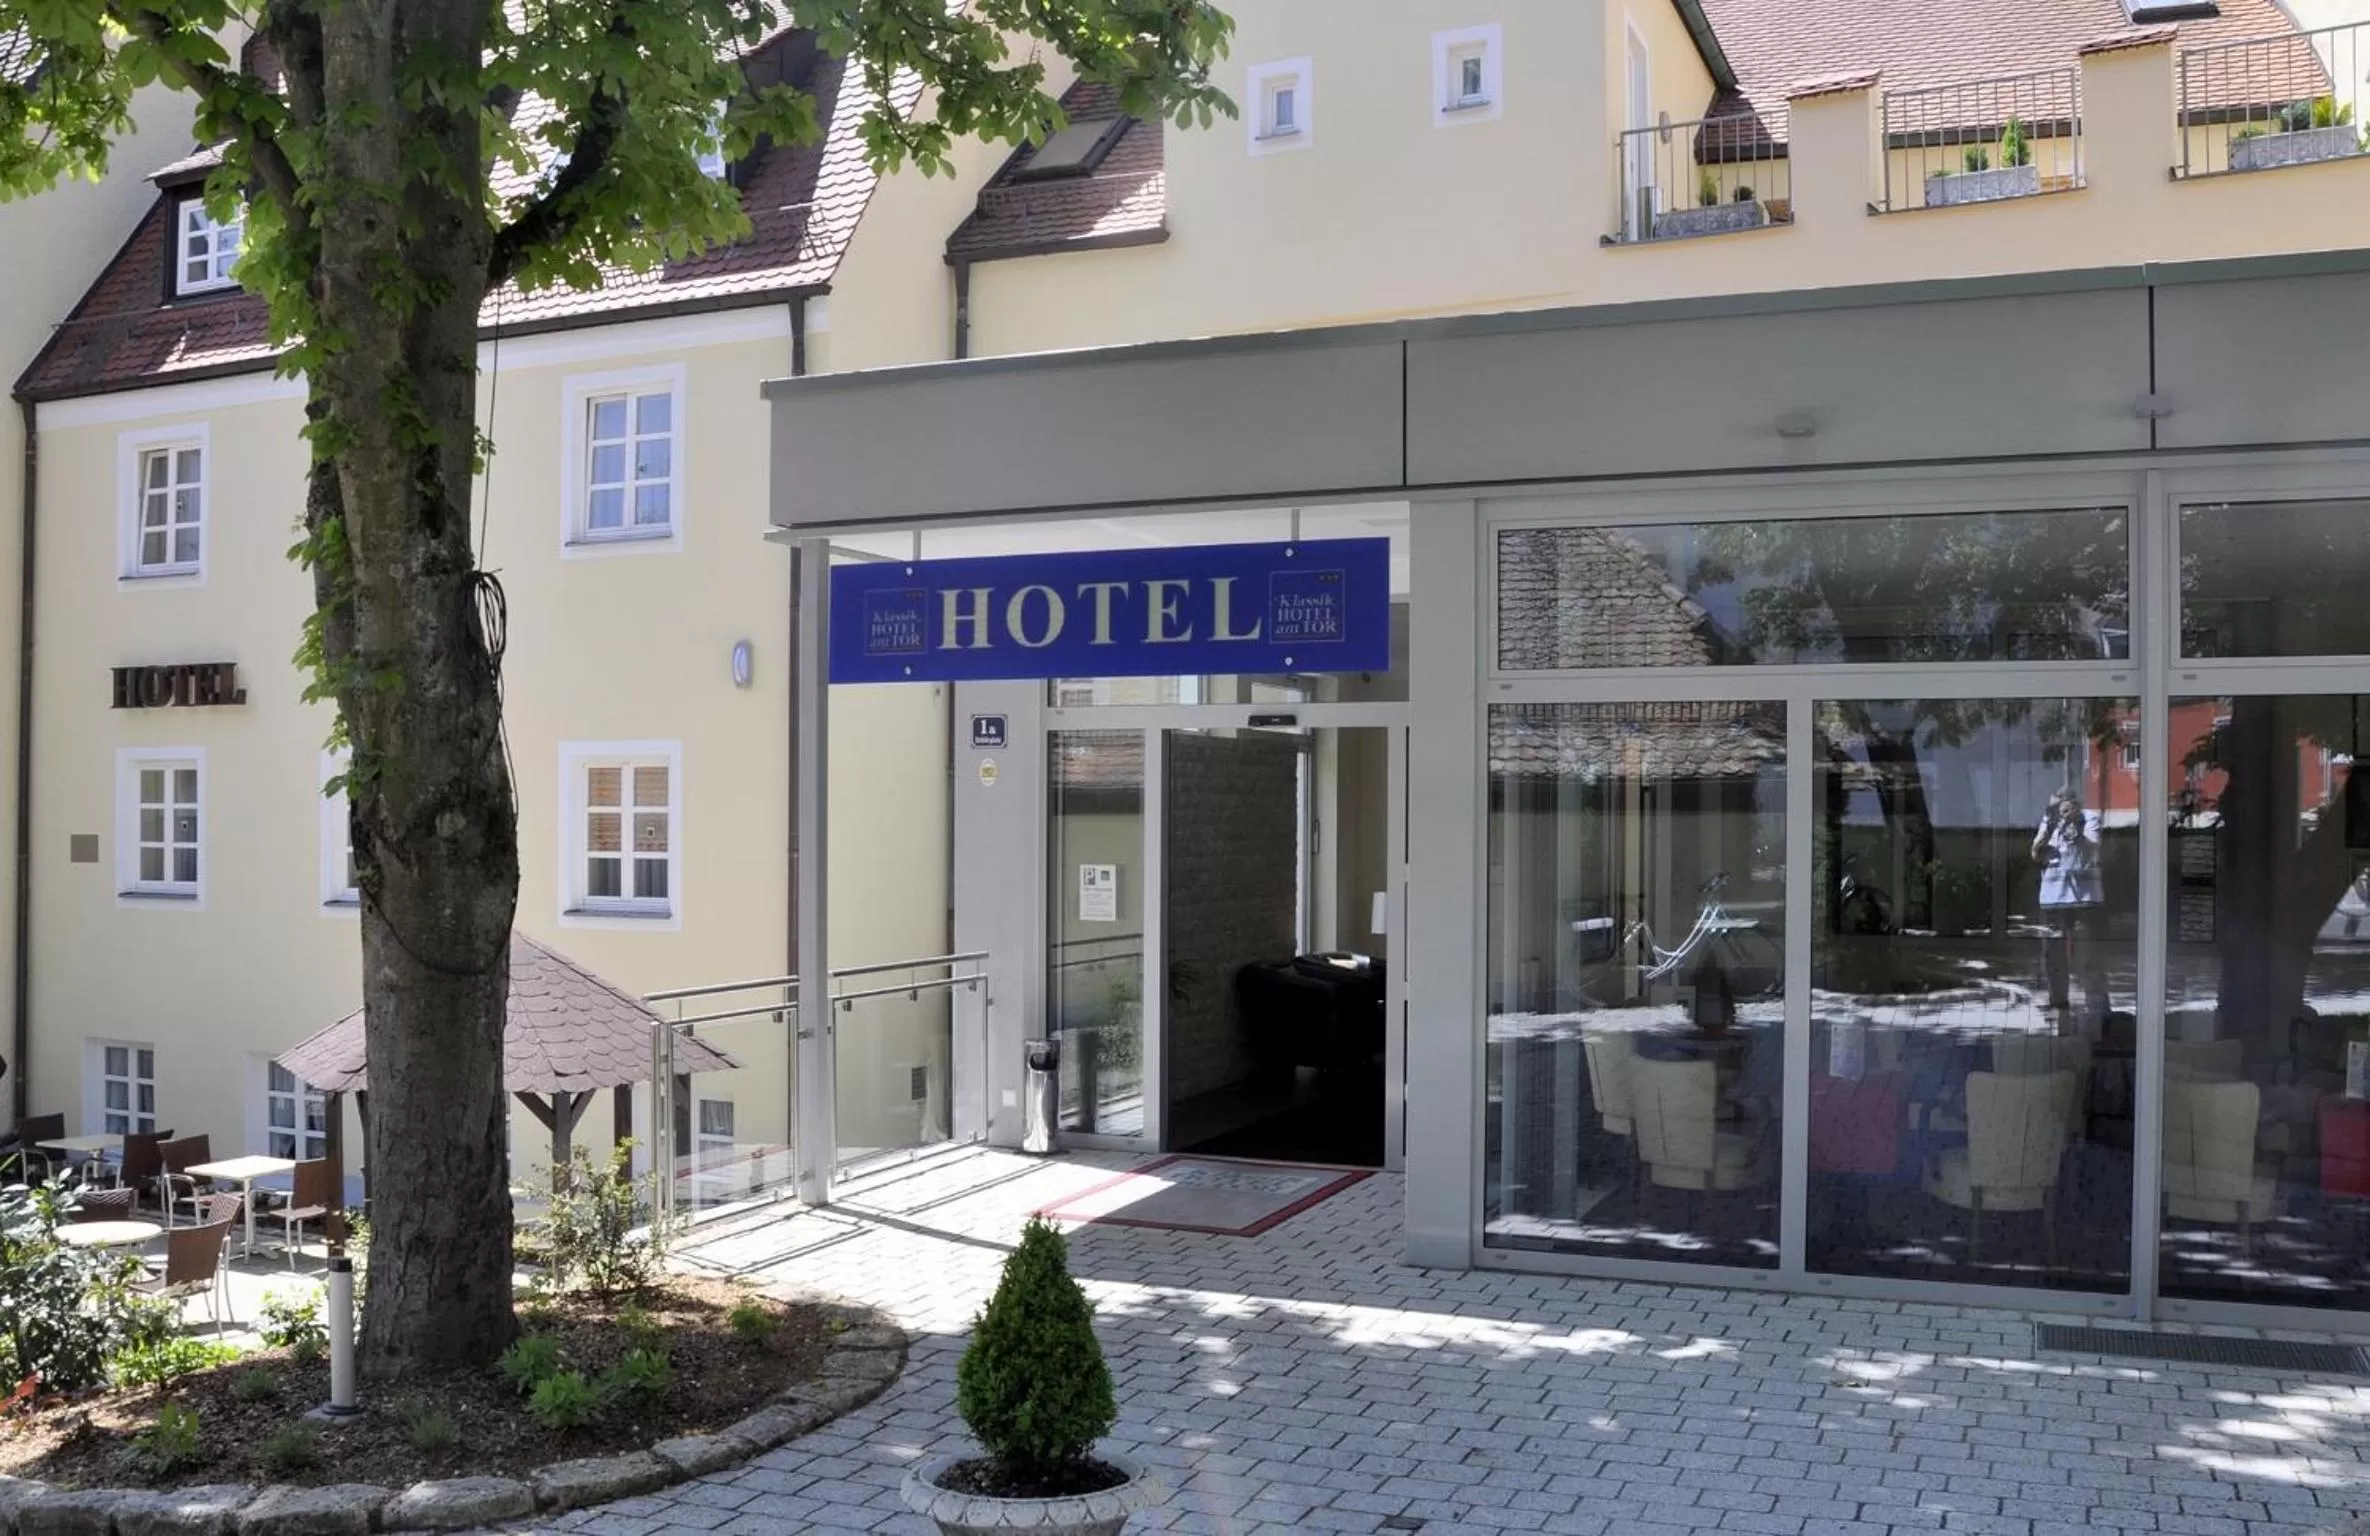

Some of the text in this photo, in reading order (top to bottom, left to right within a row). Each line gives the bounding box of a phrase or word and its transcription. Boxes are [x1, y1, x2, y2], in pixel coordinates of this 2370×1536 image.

[936, 576, 1262, 650] HOTEL
[1277, 607, 1333, 622] HOTEL
[872, 622, 918, 637] HOTEL
[1275, 619, 1337, 634] am TOR
[892, 633, 922, 648] TOR
[110, 662, 246, 708] HOTEL
